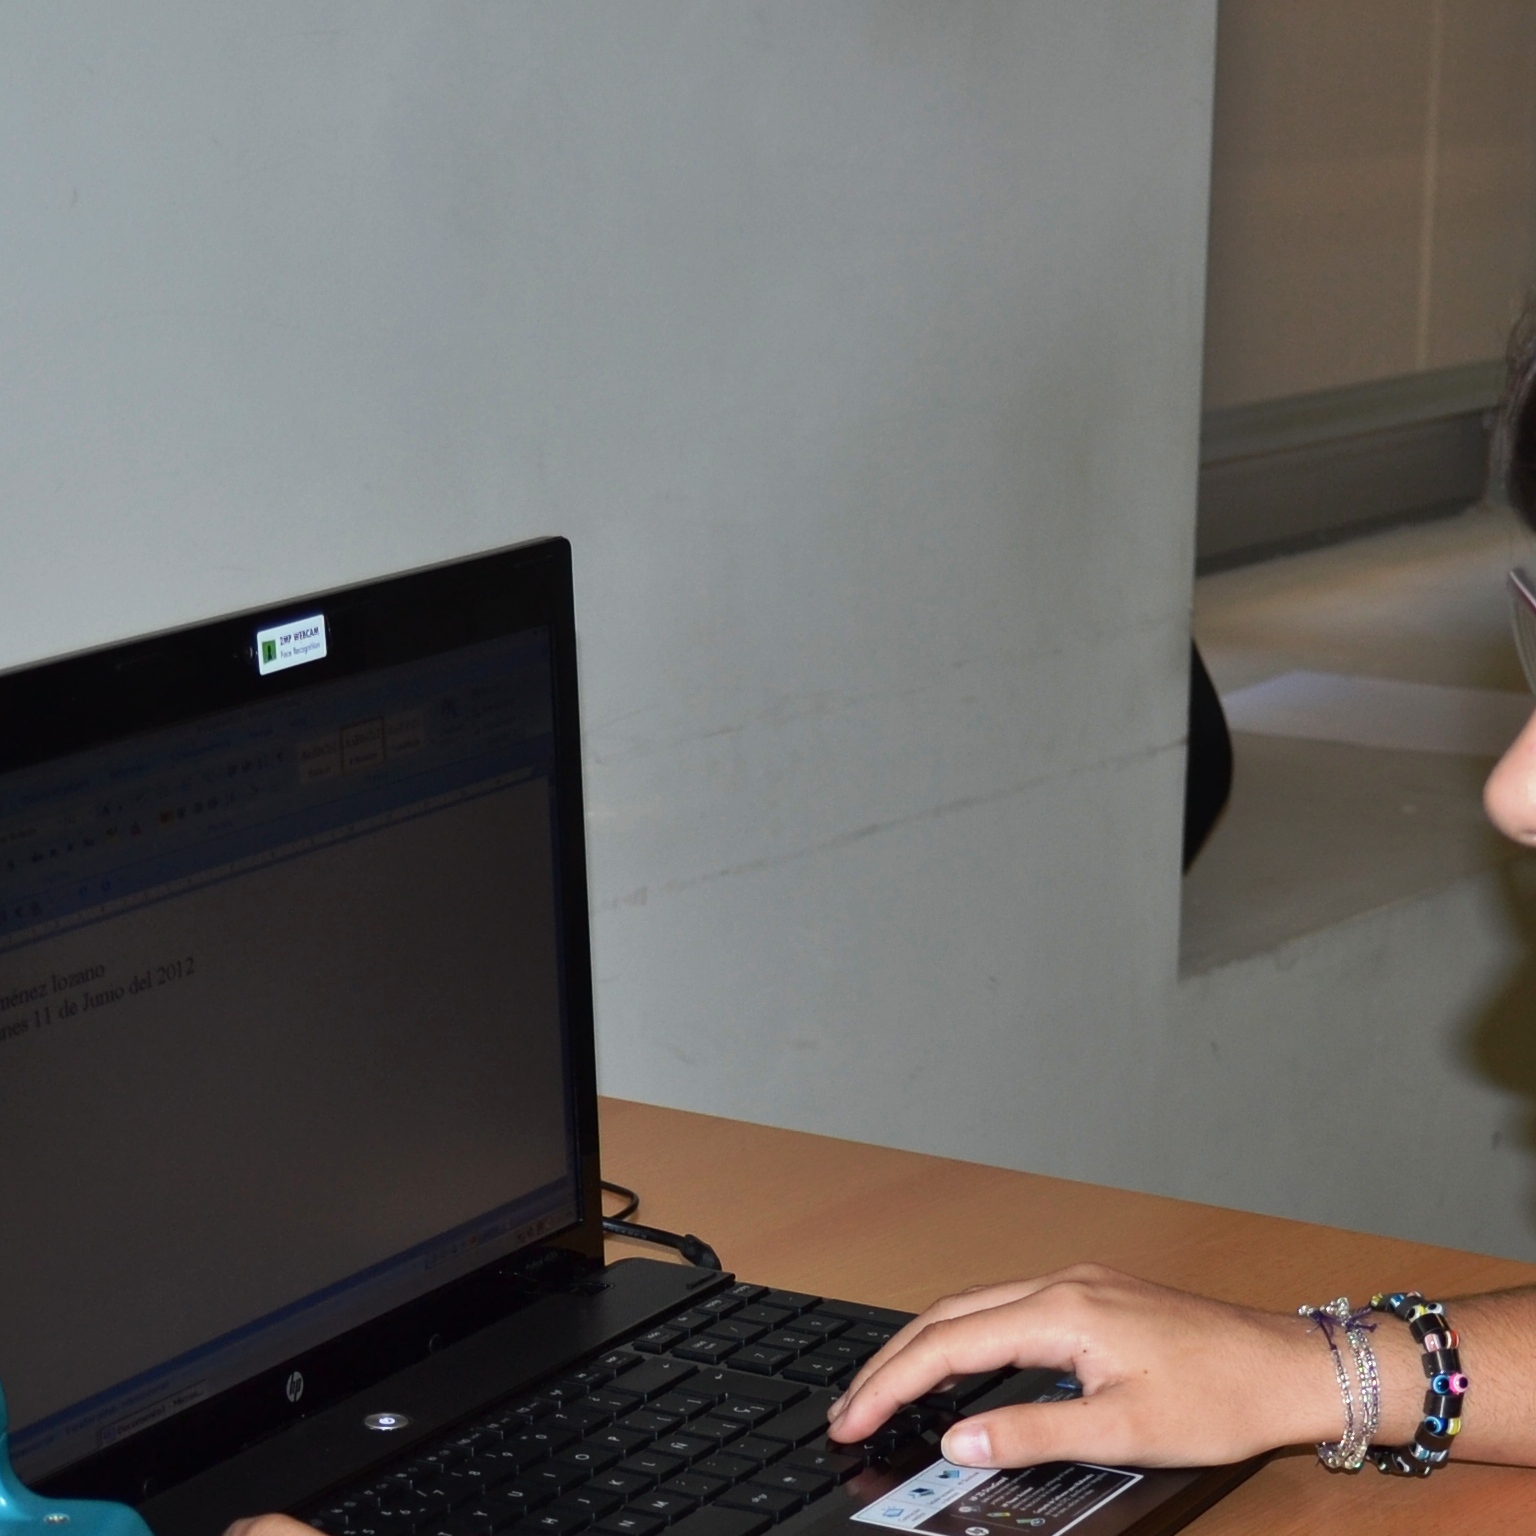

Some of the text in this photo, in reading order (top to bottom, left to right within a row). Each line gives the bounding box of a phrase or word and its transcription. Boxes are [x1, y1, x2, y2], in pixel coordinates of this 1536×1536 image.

[33, 1006, 53, 1029] 11
[57, 999, 80, 1020] de
[82, 987, 126, 1014] Junio
[128, 971, 154, 996] del
[156, 956, 197, 986] 2012
[52, 964, 106, 992] lozano
